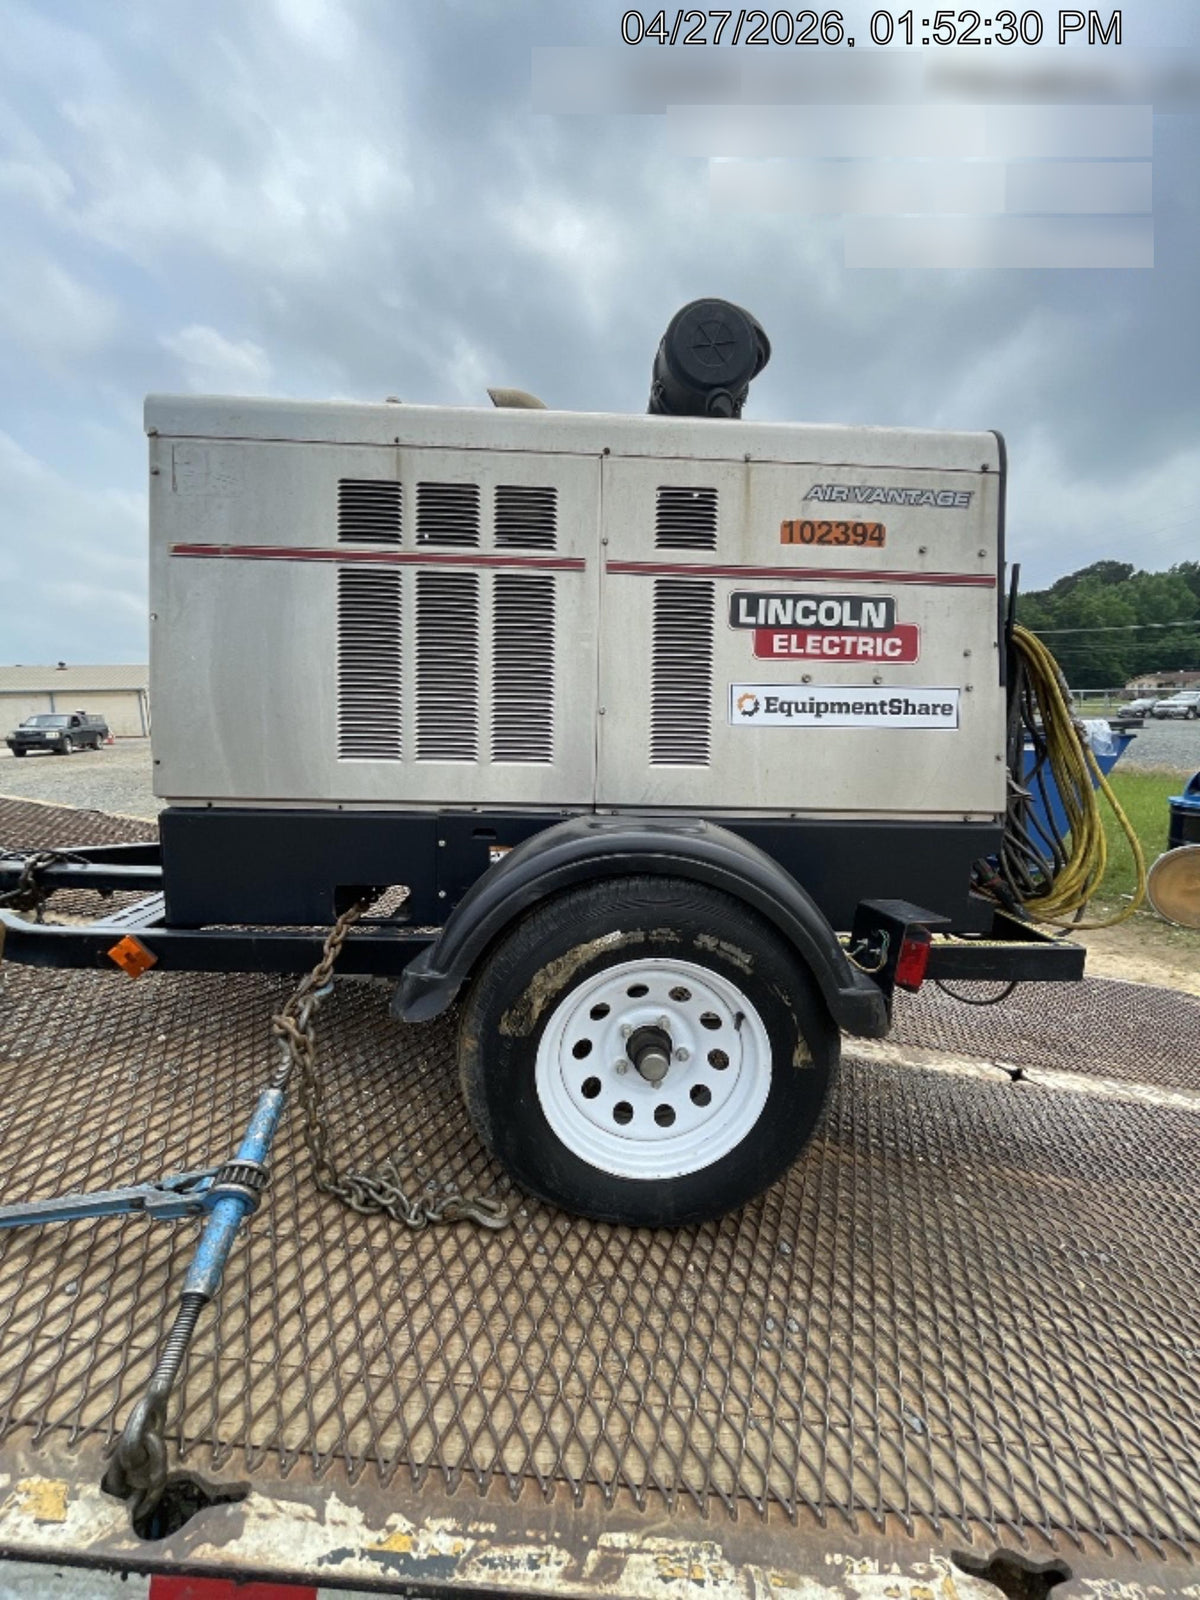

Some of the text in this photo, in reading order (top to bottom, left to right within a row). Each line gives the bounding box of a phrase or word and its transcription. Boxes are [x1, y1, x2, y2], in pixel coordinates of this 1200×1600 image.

[783, 520, 885, 546] 102394
[738, 598, 887, 628] LINCOLN
[772, 633, 902, 657] ELECTRIC
[764, 696, 954, 717] EquipmentShare
